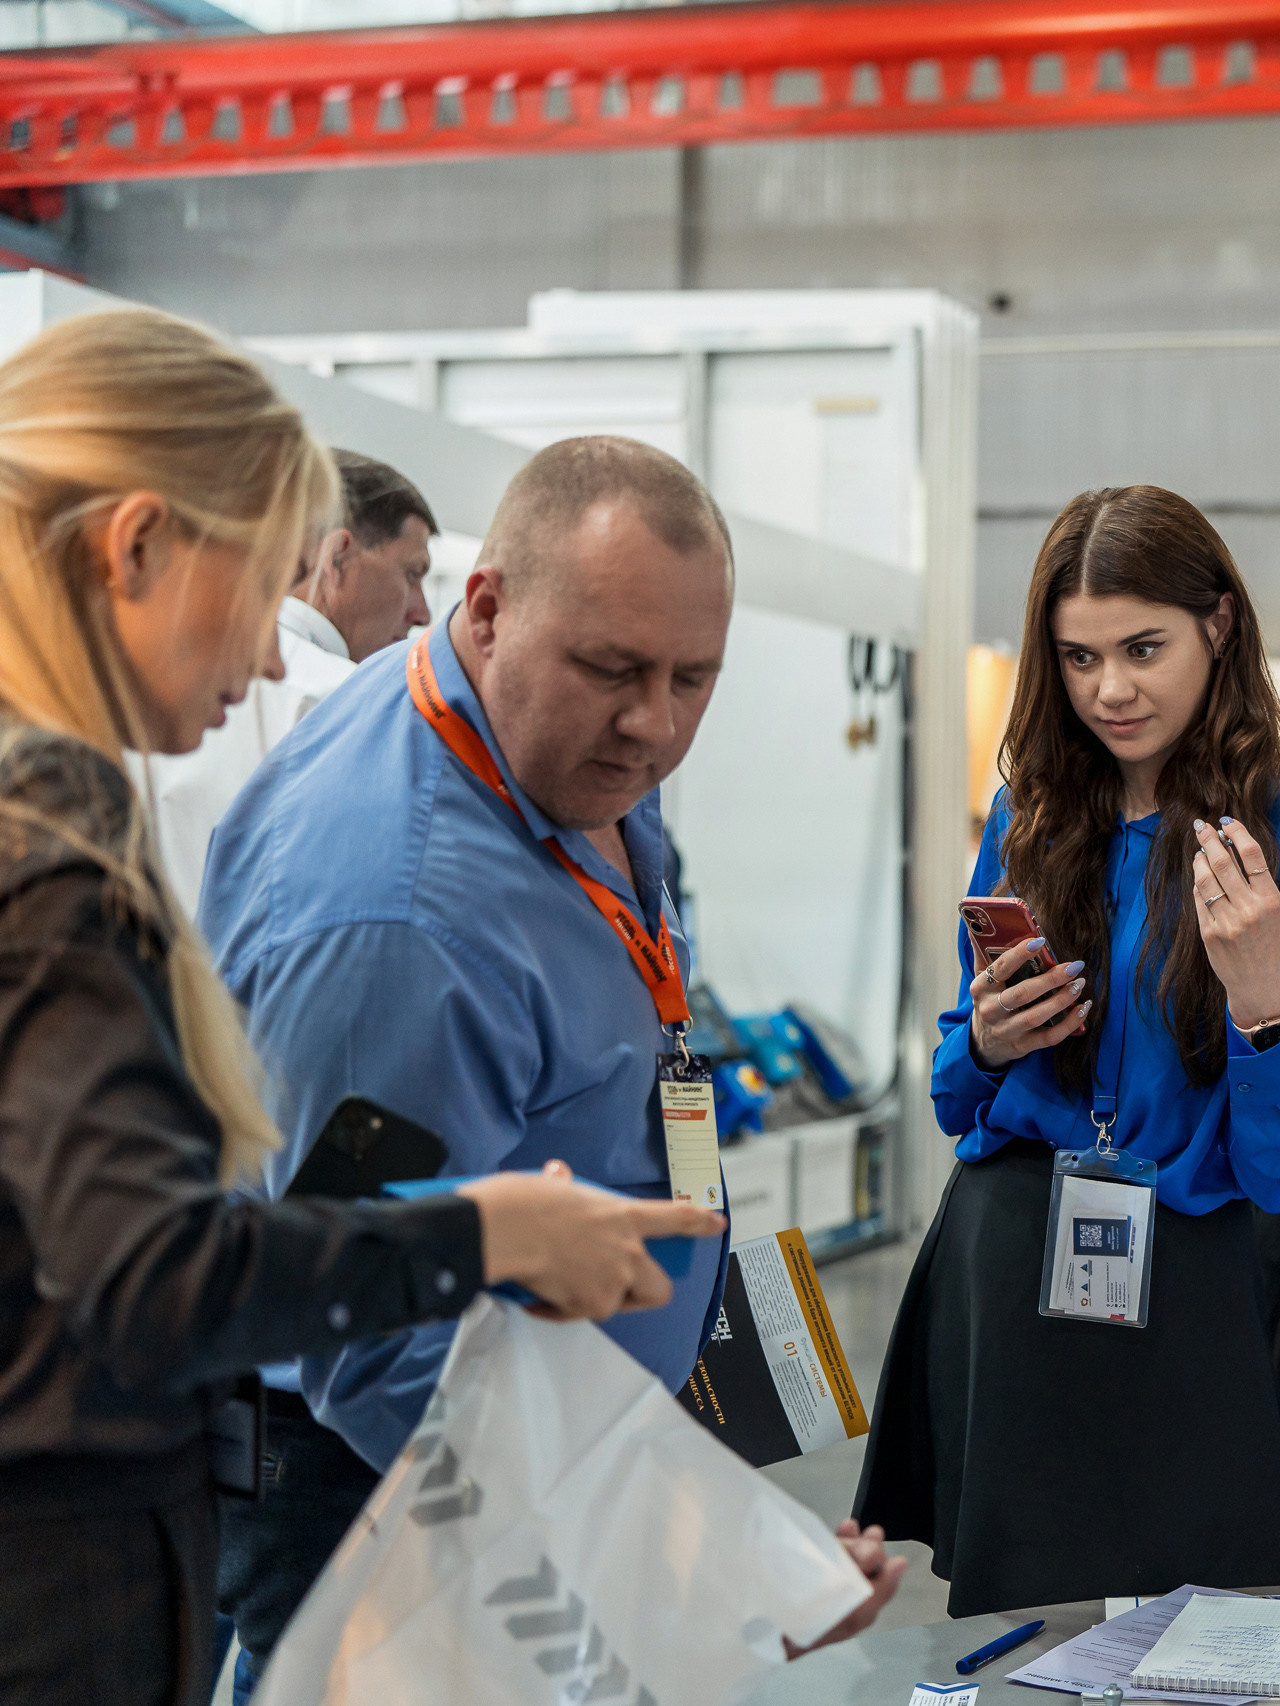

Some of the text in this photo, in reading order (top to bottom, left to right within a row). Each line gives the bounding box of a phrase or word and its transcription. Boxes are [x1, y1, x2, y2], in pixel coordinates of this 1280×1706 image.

[783, 1341, 798, 1358] 01
[688, 1373, 704, 1412] ОЦЕССА
[698, 1356, 726, 1426] ЕЗОПАСНОСТИ
[809, 1362, 827, 1398] системы
